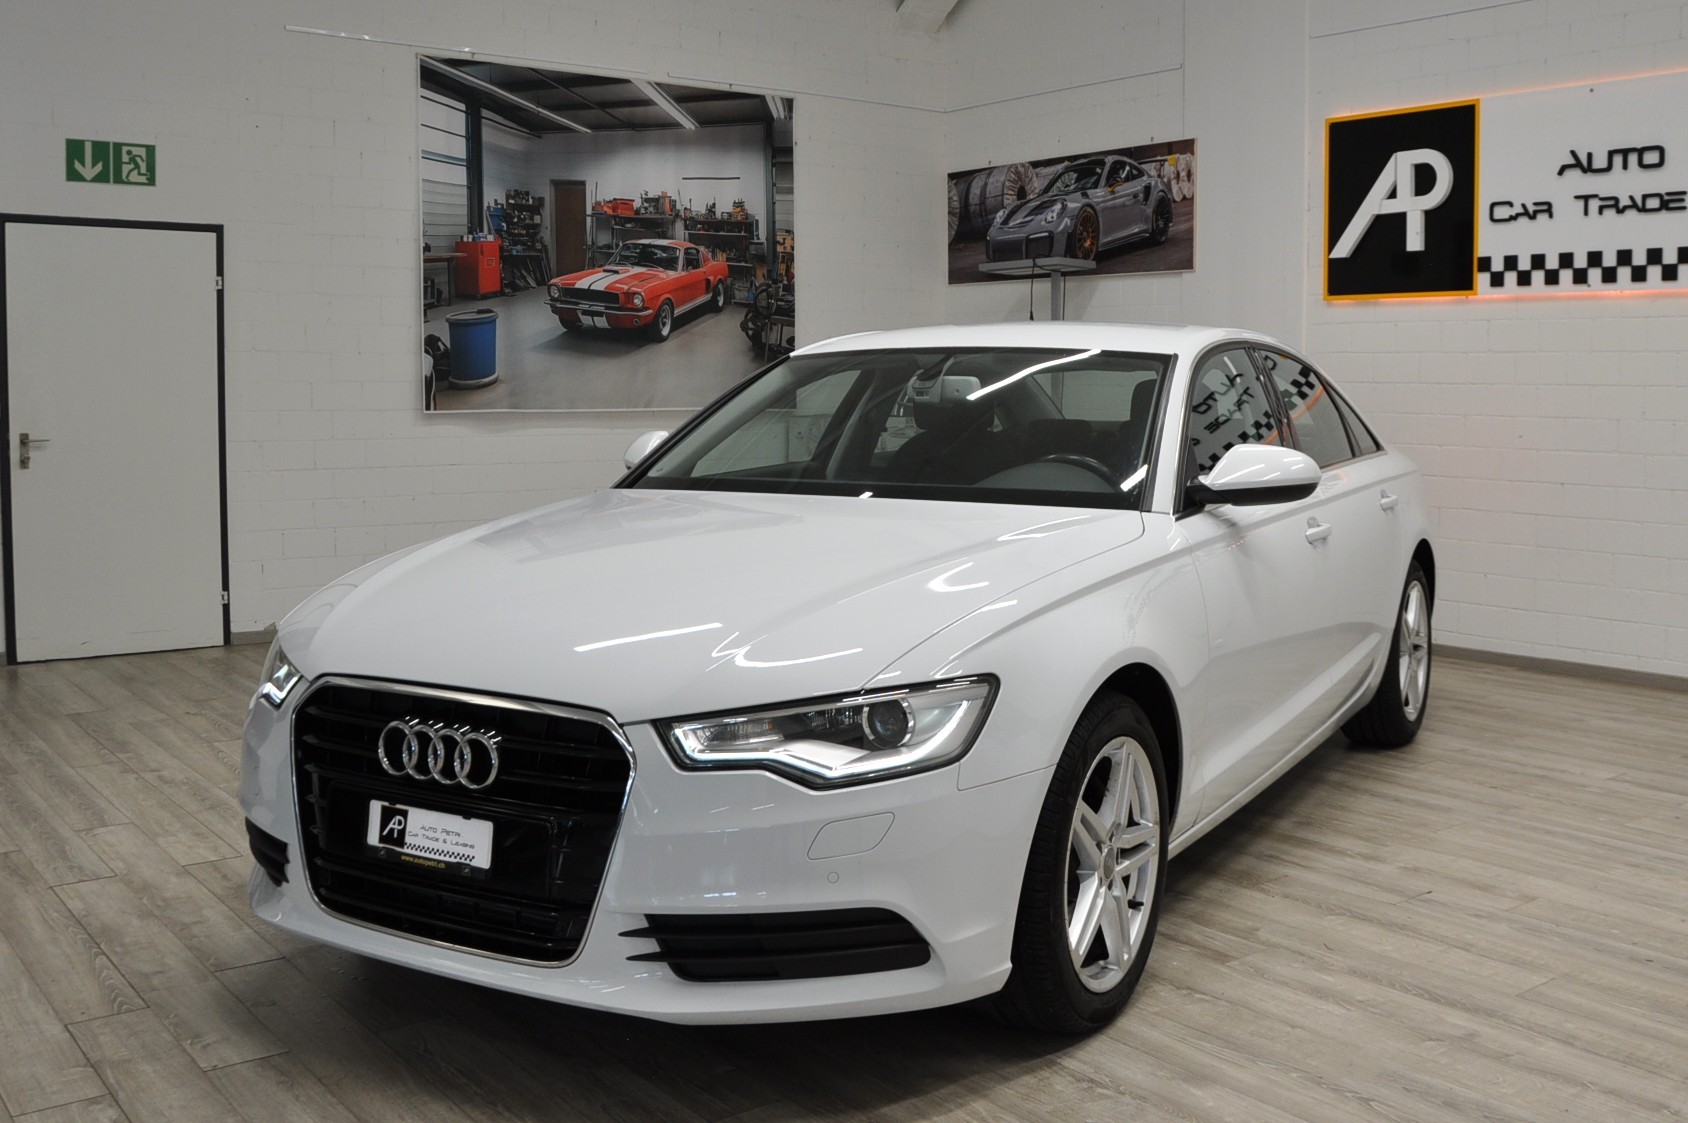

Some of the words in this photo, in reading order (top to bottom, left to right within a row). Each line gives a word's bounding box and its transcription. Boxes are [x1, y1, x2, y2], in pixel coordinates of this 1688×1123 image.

[1557, 145, 1665, 176] AUTO
[1329, 148, 1454, 259] AP
[1489, 201, 1553, 223] CAR
[1574, 191, 1687, 216] TRADE
[382, 815, 405, 838] AP
[419, 825, 438, 833] AUTO
[401, 855, 446, 868] www.autopetri.ch
